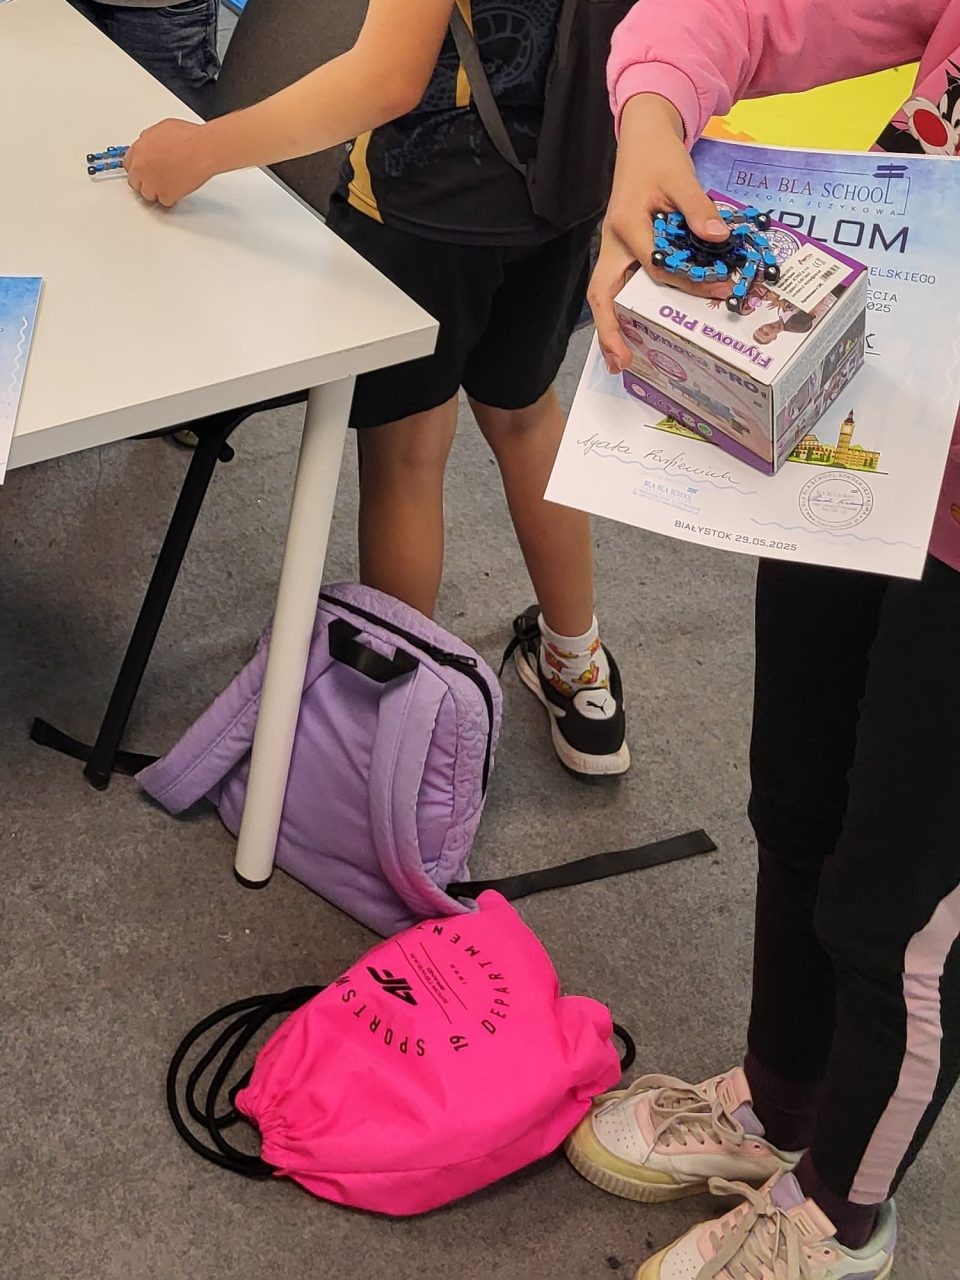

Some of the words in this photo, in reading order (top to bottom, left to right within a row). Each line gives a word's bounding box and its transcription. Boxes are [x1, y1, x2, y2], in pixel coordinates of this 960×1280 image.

[735, 170, 769, 190] BLA
[778, 177, 813, 196] BLA
[821, 180, 894, 205] SCHOOL
[765, 208, 910, 254] PLOM
[870, 266, 936, 285] ELSKIEGO
[866, 289, 897, 303] ĘCIA
[659, 305, 699, 332] PRO
[702, 323, 774, 369] Flynova
[715, 364, 759, 393] PRO
[674, 520, 733, 541] BIAŁYSTOK
[735, 535, 798, 552] 29.05.2025
[335, 974, 426, 1057] SPORTSW
